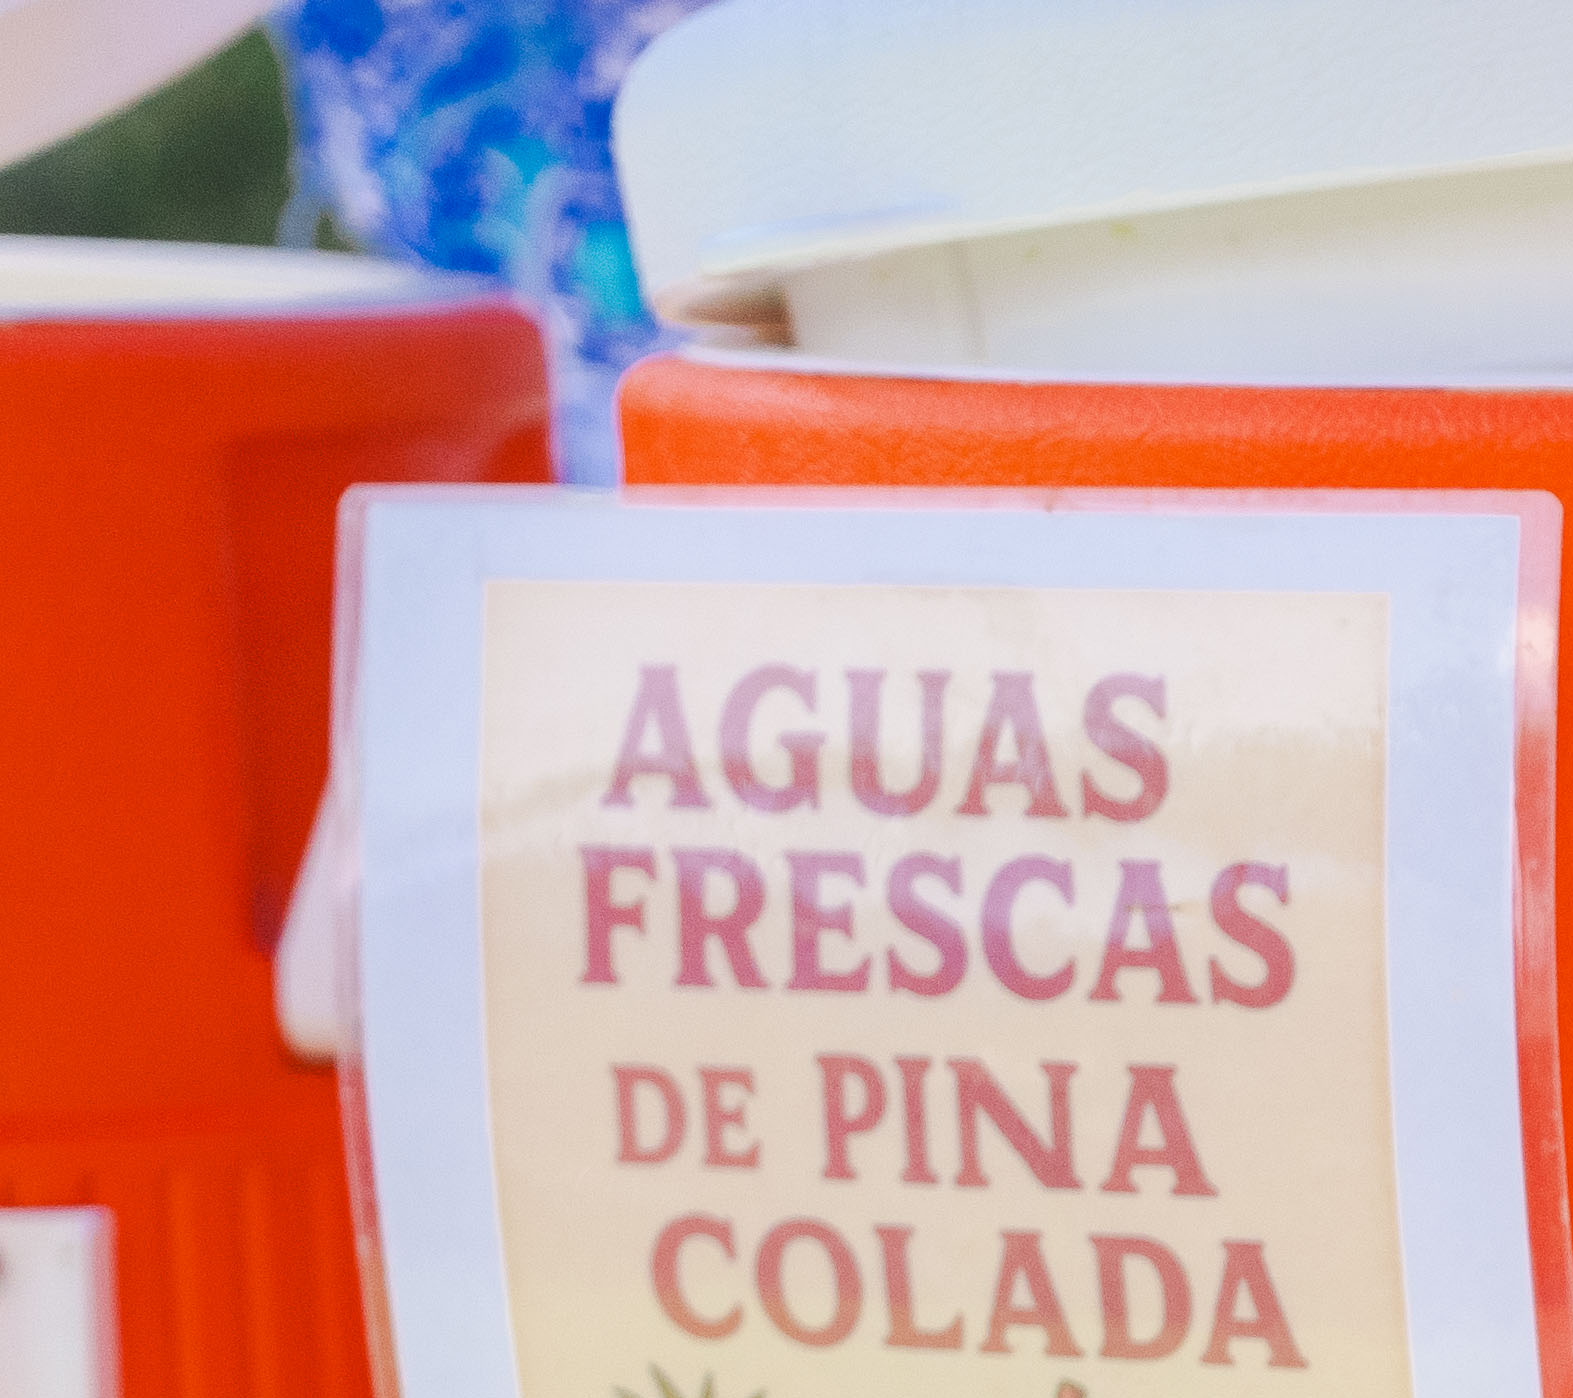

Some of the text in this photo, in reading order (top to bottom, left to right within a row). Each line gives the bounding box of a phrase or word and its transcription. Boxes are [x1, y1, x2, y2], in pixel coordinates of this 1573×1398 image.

[604, 662, 1171, 823] AGUAS
[579, 841, 1297, 1010] FRESCAS
[614, 1052, 1218, 1198] DE PINA
[651, 1211, 1307, 1369] COLADA
